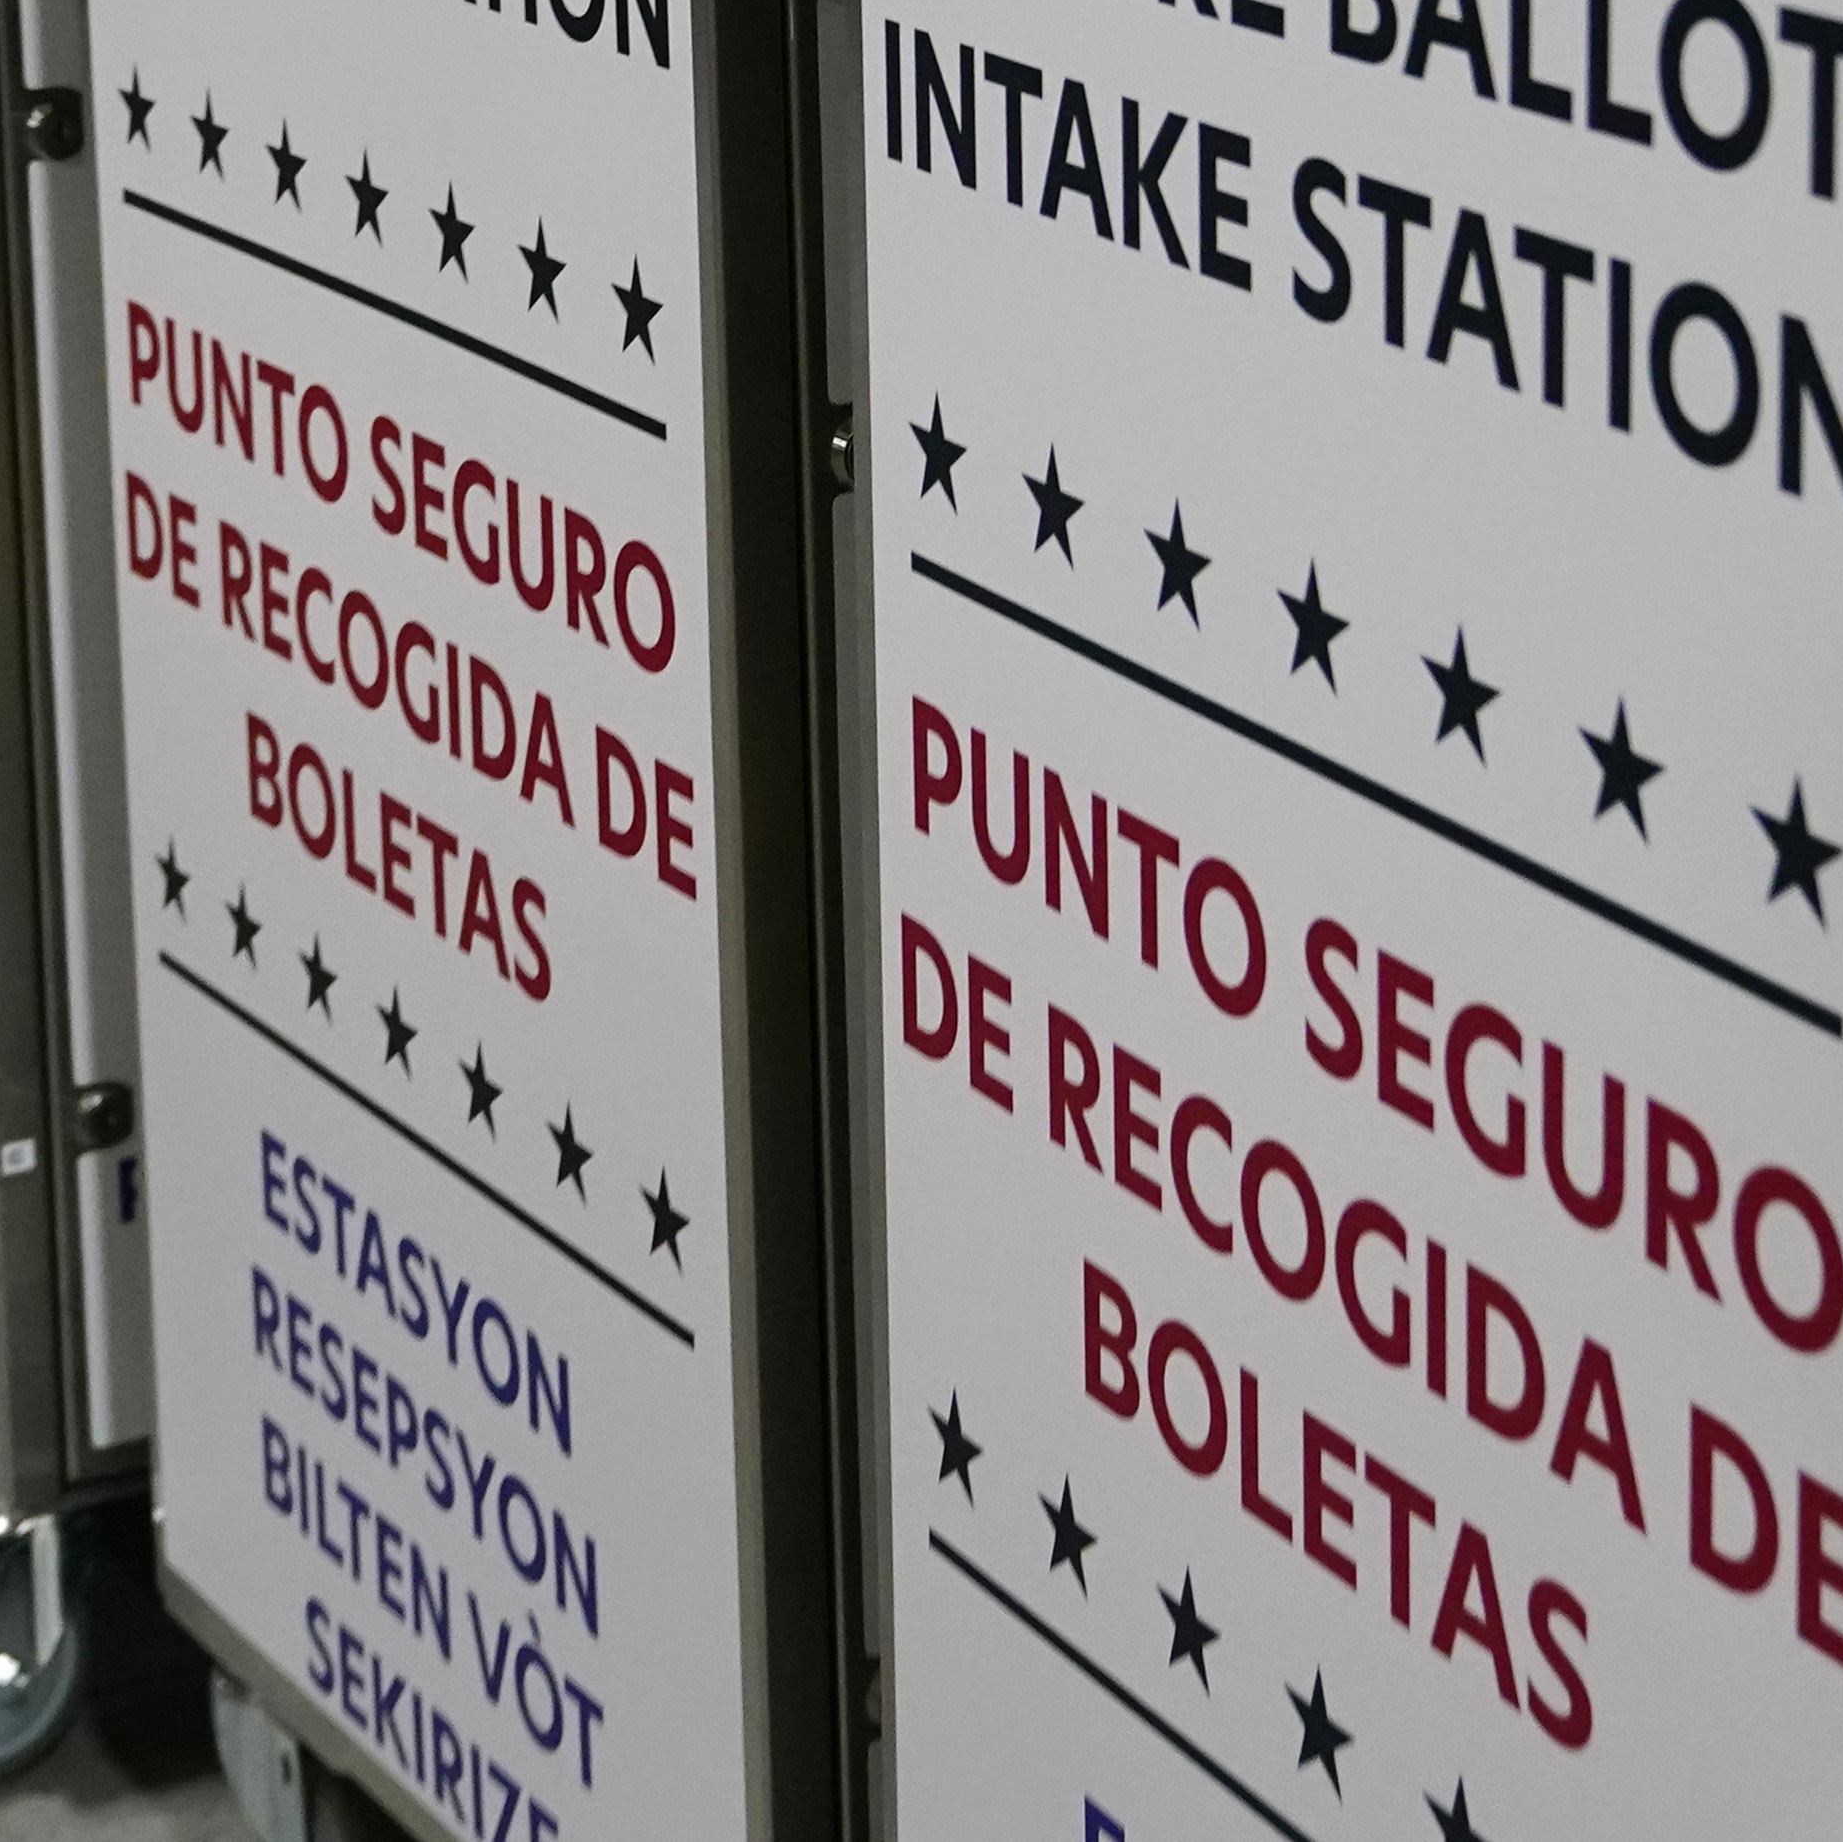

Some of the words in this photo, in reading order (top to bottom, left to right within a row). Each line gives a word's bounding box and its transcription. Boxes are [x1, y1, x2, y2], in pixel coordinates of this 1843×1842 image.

[883, 17, 1252, 293] INTAKE
[127, 300, 349, 503] PUNTO
[371, 415, 676, 673] SEGURO
[126, 470, 200, 610] DE
[219, 520, 575, 830] RECOGIDA
[596, 724, 697, 901] DE
[247, 711, 551, 1001] BOLETAS
[910, 695, 1268, 1018] PUNTO
[260, 1128, 572, 1458] ESTASYON
[900, 912, 1014, 1115] DE
[1046, 1001, 1648, 1537] RECOGIDA
[251, 1264, 599, 1639] RESEPSYON
[261, 1415, 451, 1663] BILTEN
[1083, 1256, 1595, 1753] BOLETAS
